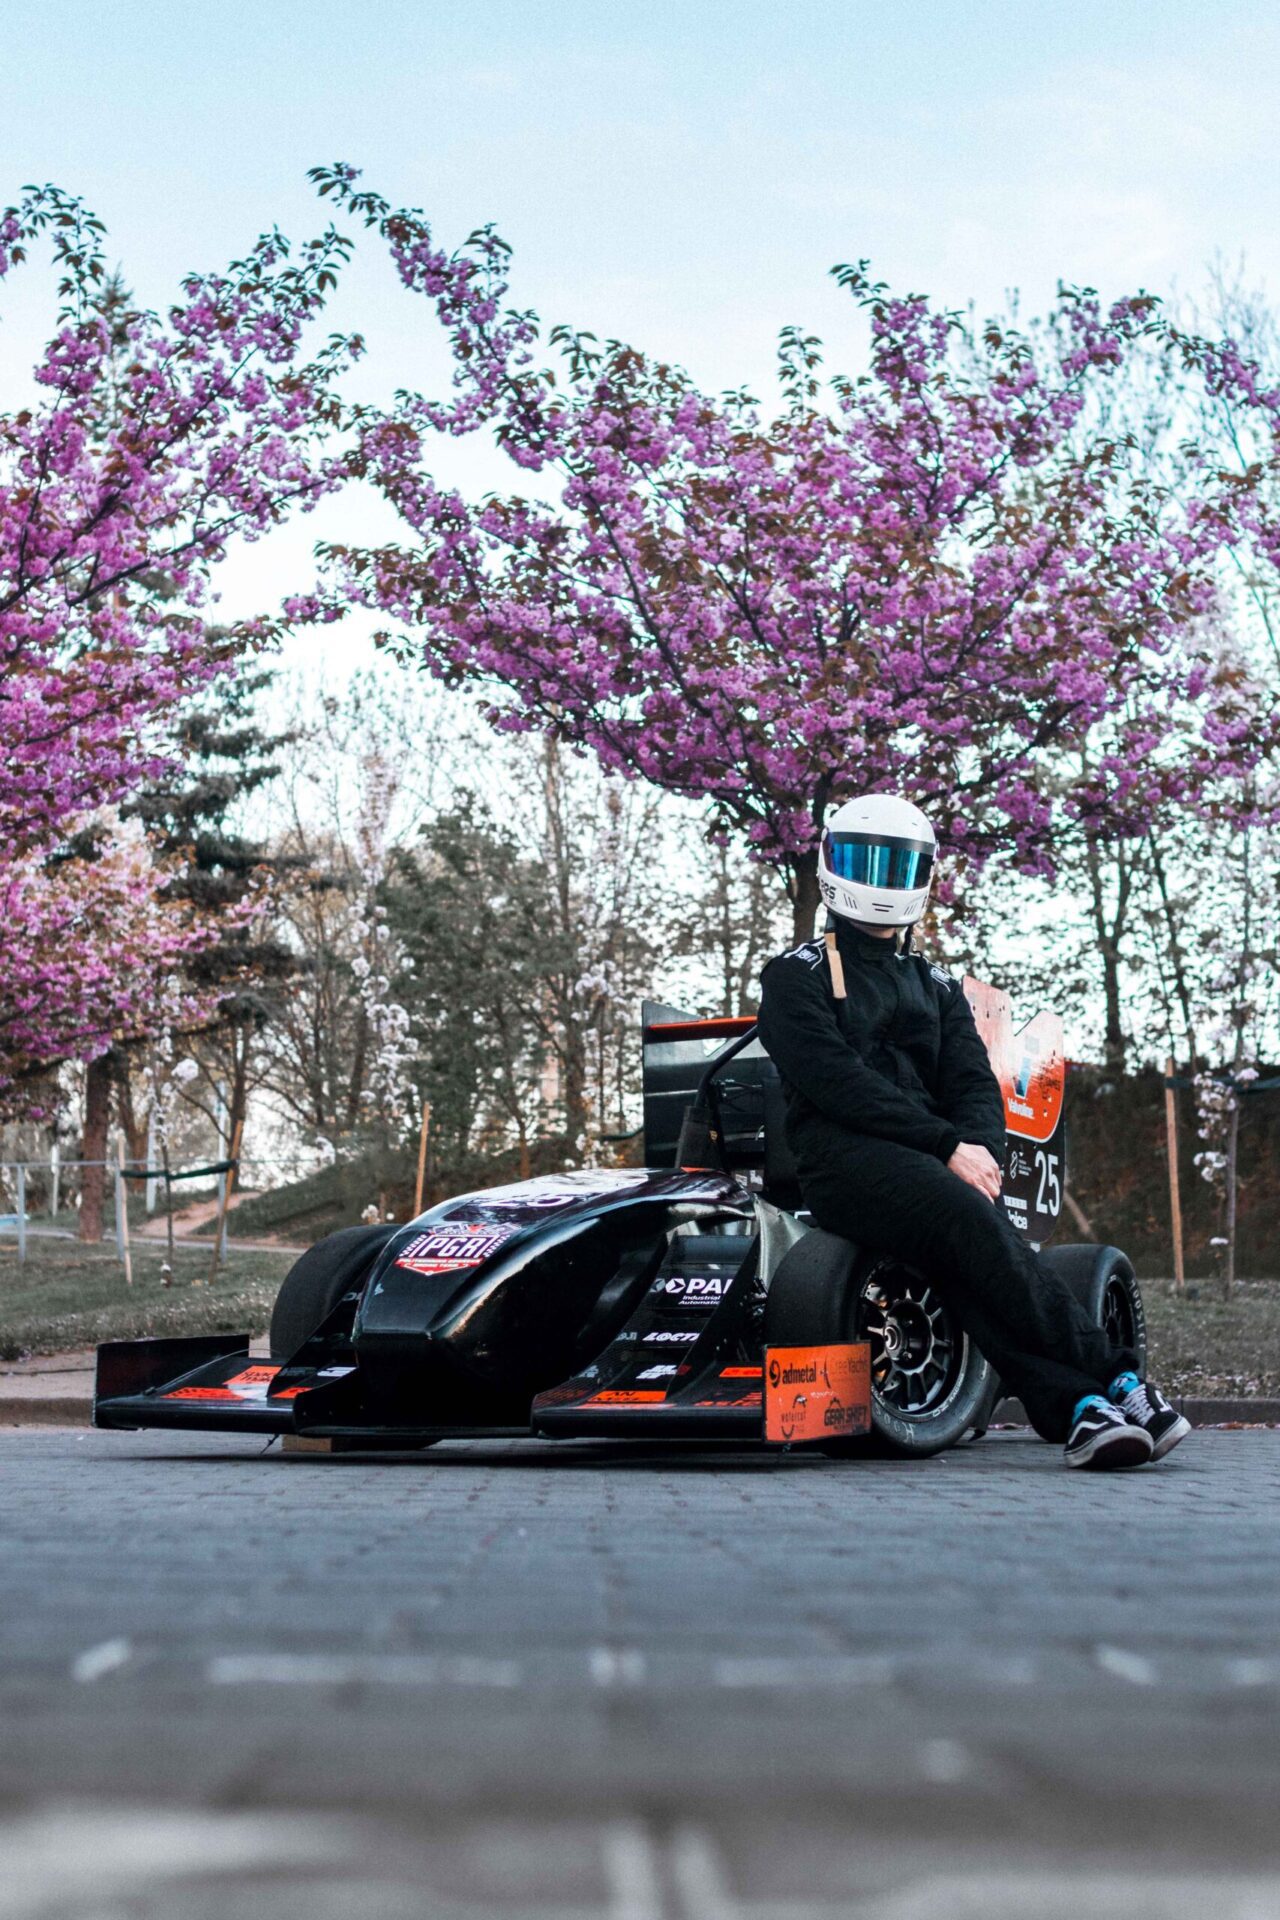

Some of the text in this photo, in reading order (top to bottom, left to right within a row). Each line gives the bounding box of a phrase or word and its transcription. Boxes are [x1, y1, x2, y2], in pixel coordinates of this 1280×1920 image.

[1034, 1150, 1060, 1217] 25
[418, 1236, 486, 1257] PGR
[782, 1361, 817, 1384] admetal
